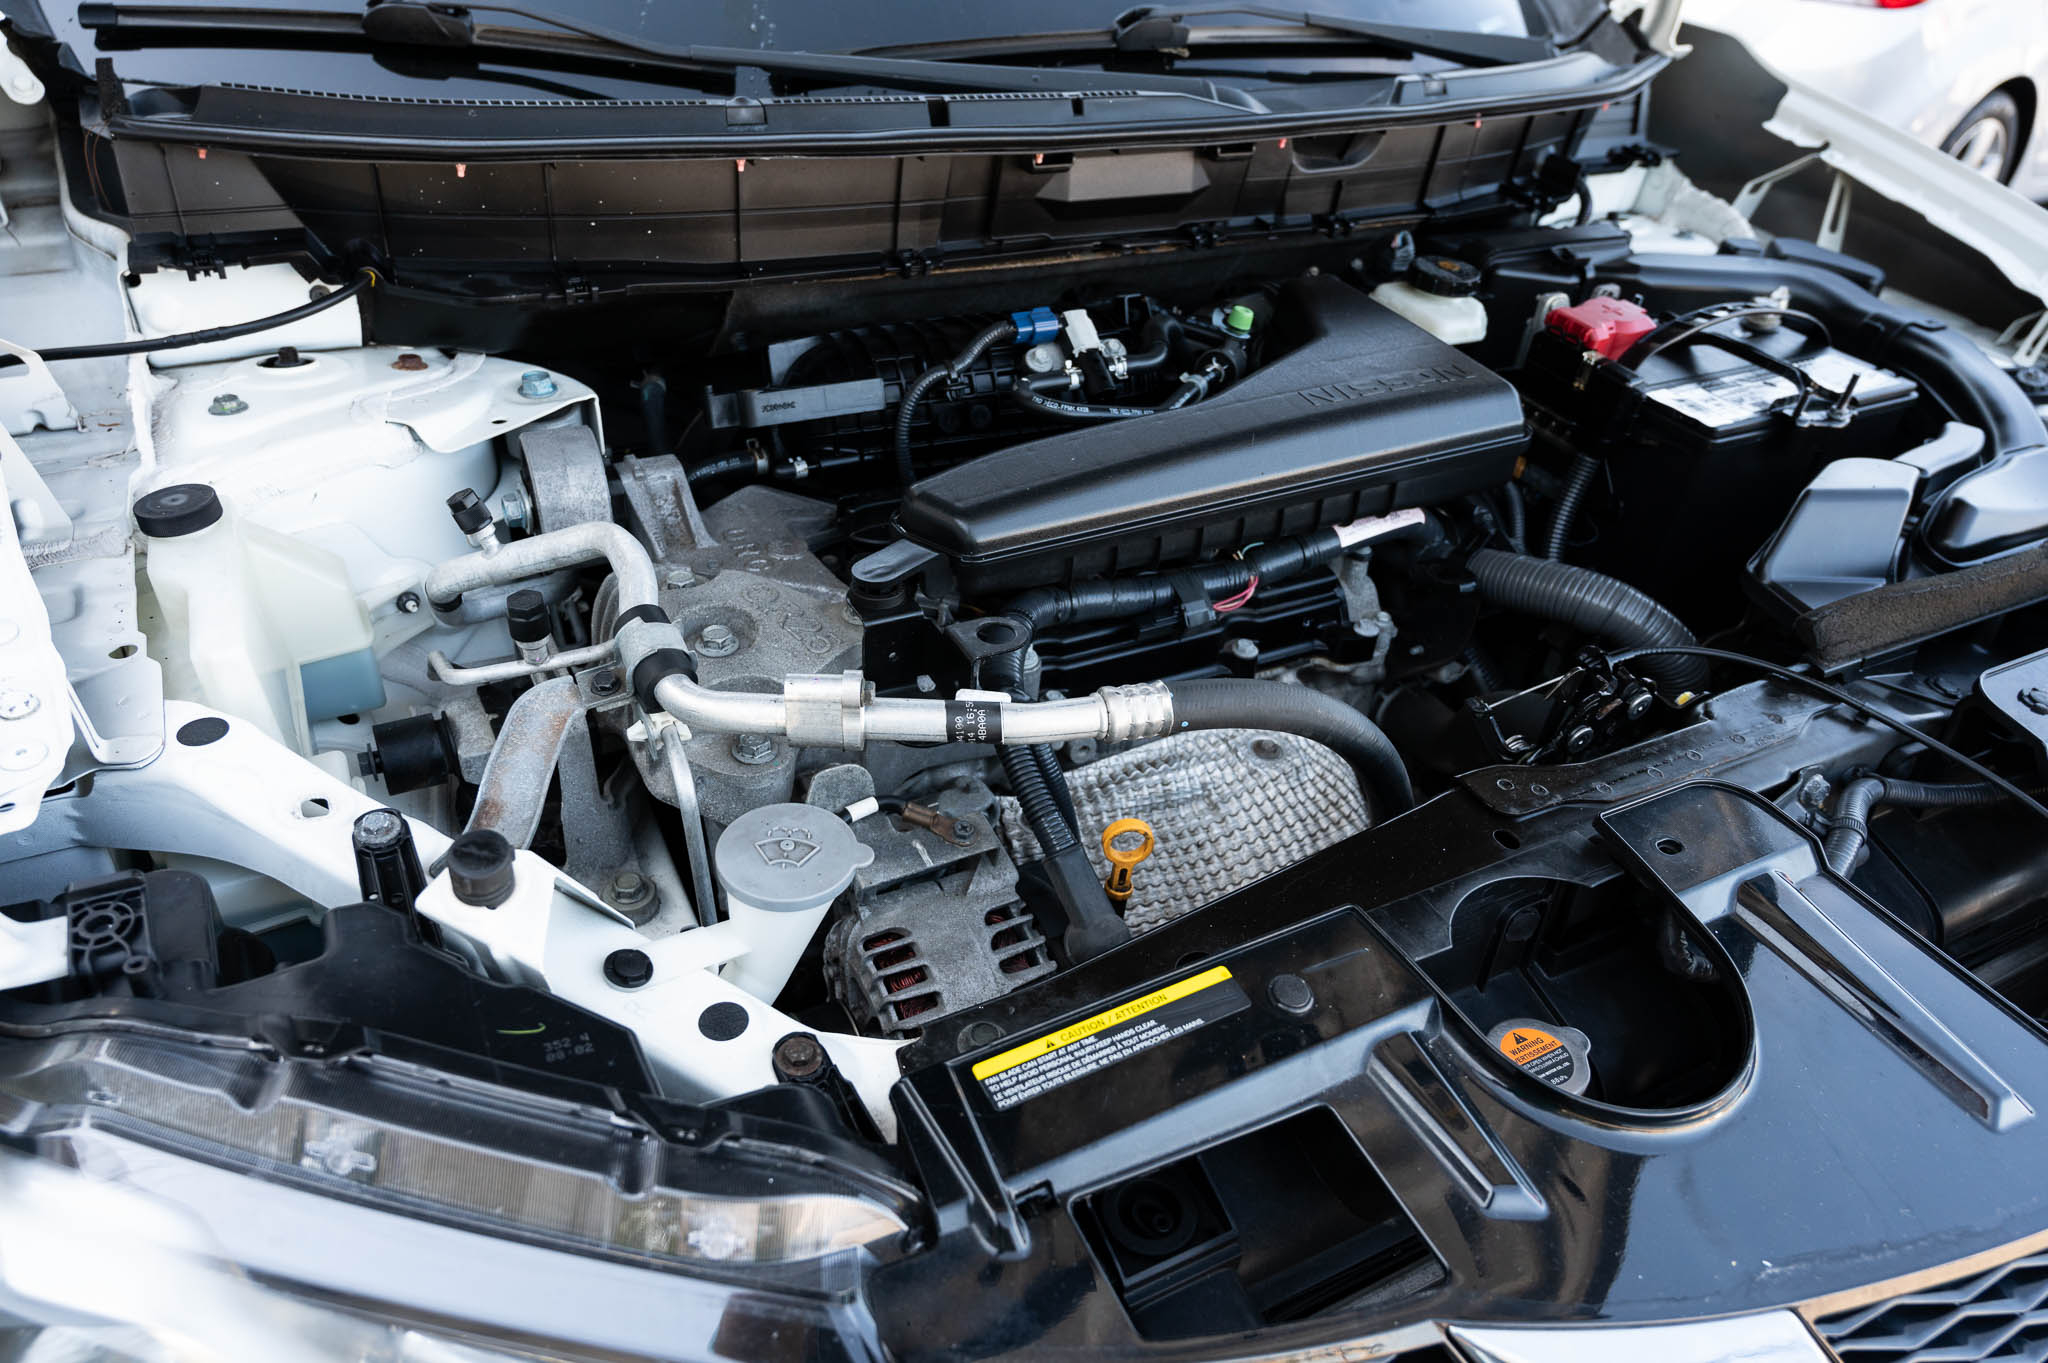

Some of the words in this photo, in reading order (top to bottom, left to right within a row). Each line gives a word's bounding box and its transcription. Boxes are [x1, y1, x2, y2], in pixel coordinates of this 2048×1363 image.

[1298, 364, 1476, 407] NISSAN
[1059, 1018, 1105, 1042] CAUTION
[1114, 992, 1167, 1020] ATTENTION
[984, 1074, 999, 1085] FAN
[998, 1065, 1022, 1080] BLADE
[1020, 1058, 1037, 1071] CAN
[1036, 1050, 1058, 1064] START
[1056, 1046, 1067, 1056] AT
[1065, 1041, 1081, 1052] ANY
[988, 1083, 1000, 1093] TO
[998, 1075, 1018, 1089] HELP
[1017, 1067, 1040, 1081] AVOID
[1038, 1052, 1075, 1073] PERSONAL
[1111, 1027, 1135, 1042] HANDS
[992, 1091, 1004, 1101] LE
[1001, 1073, 1047, 1097] VENTILATEUR
[1045, 1063, 1072, 1080] RISQUE
[1070, 1059, 1082, 1069] DE
[1121, 1035, 1139, 1047] TOUT
[1509, 1037, 1544, 1056] WARNING
[1514, 1040, 1557, 1064] VERTISSEMENT
[996, 1094, 1019, 1108] POUR
[1041, 1076, 1064, 1090] TOUTE
